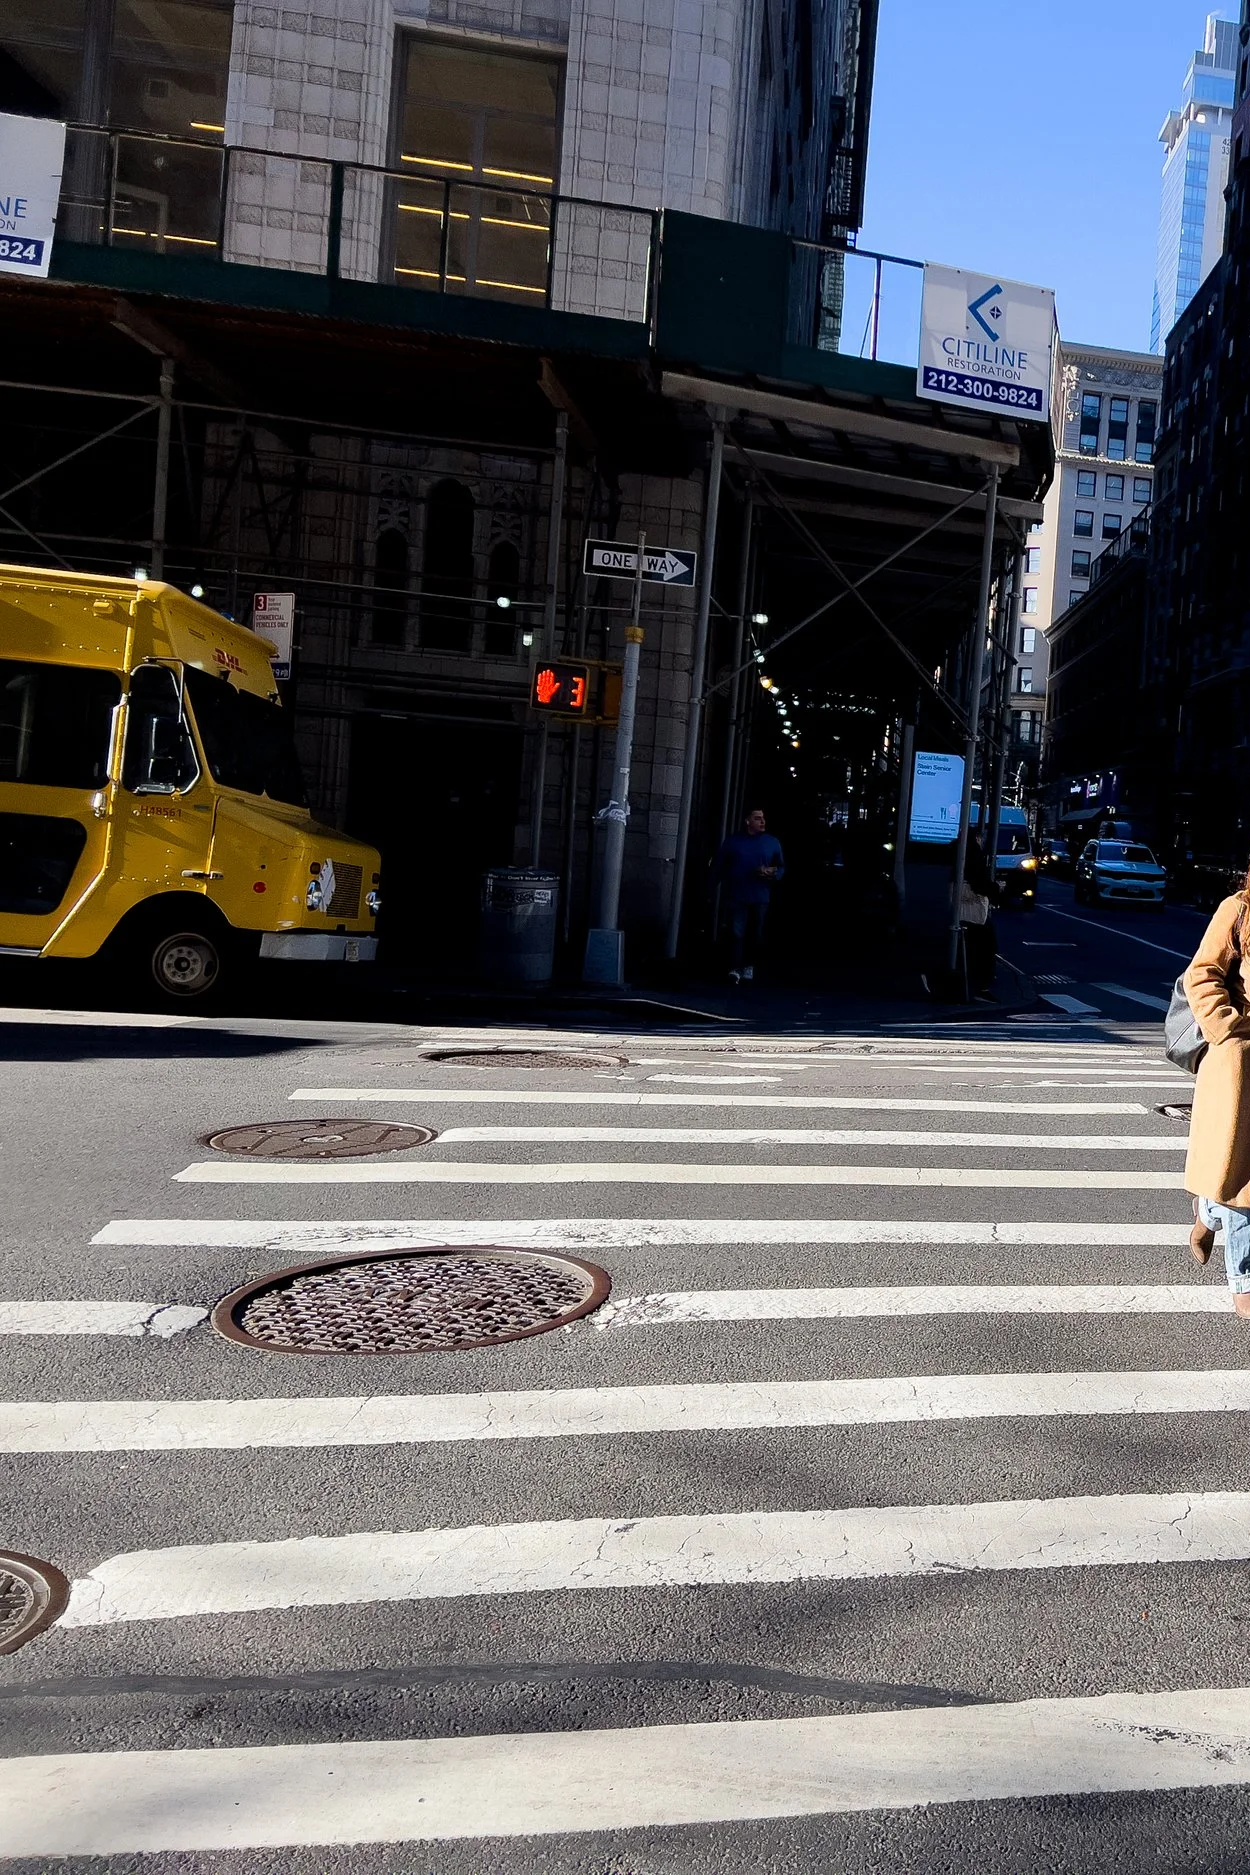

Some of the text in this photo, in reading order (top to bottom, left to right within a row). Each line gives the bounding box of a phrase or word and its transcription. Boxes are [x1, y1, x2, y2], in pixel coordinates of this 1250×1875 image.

[942, 337, 1028, 370] CITILINE
[947, 358, 1021, 380] RESTORATION
[928, 371, 1037, 407] 212-300-9824
[601, 552, 679, 573] ONE WAY
[257, 596, 265, 610] 3
[213, 647, 247, 676] DHL
[570, 677, 584, 707] 3
